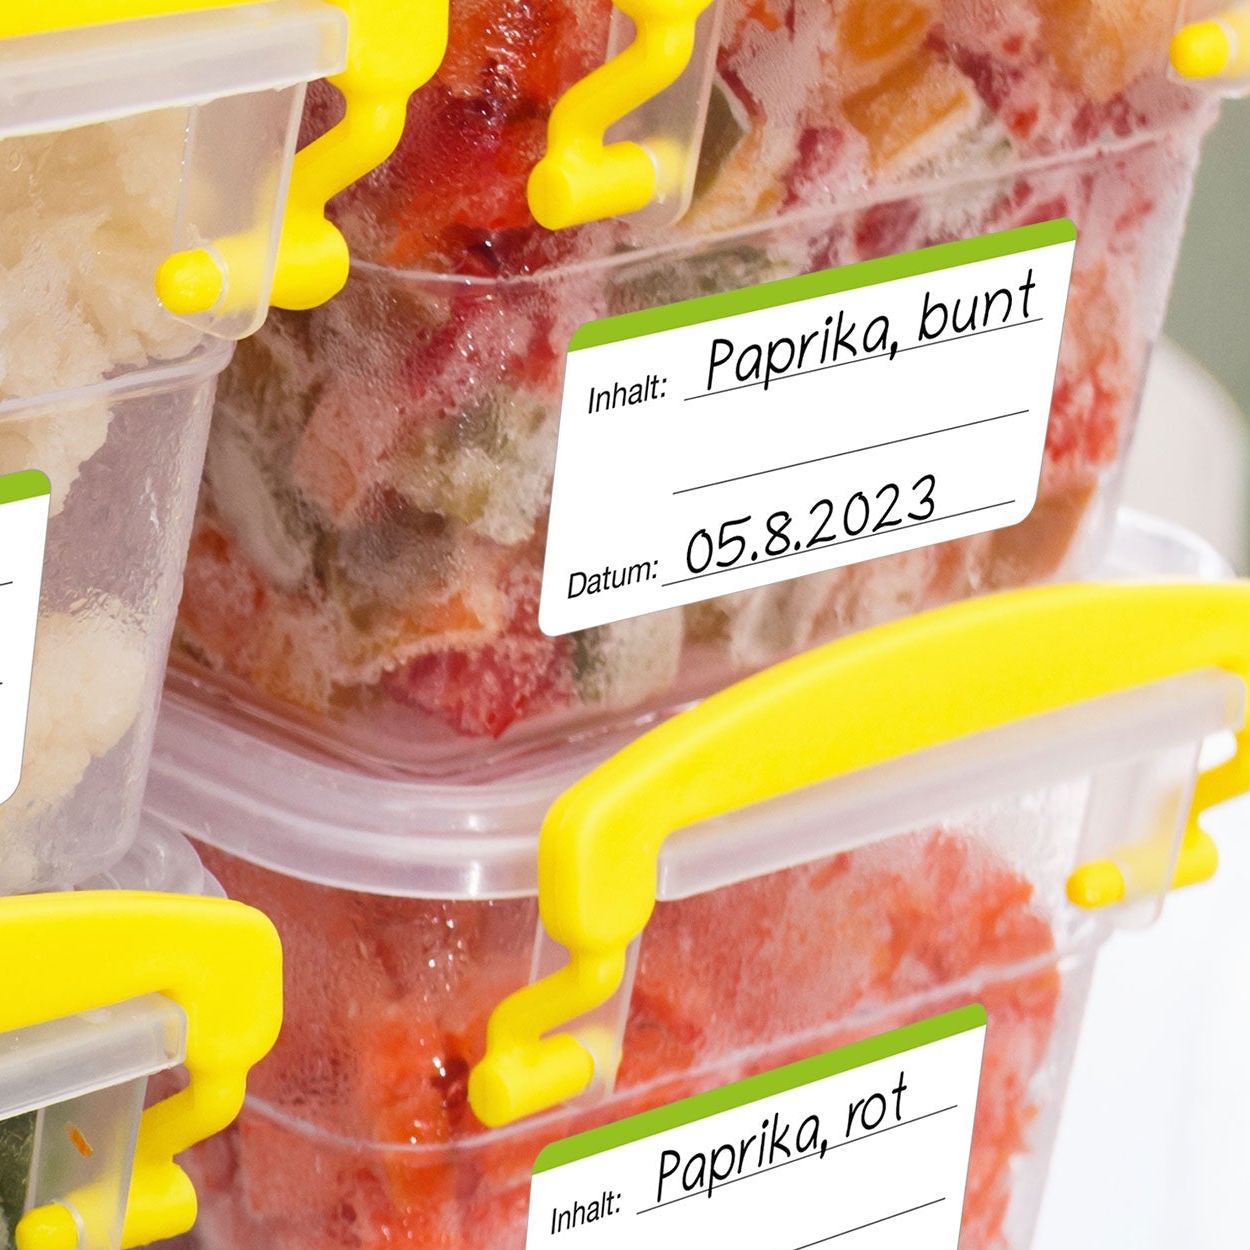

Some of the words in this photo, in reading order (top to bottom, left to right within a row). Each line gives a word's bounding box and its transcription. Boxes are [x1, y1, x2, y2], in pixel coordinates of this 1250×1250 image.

[587, 374, 667, 414] Inhalt:
[707, 310, 899, 391] Paprika,
[917, 268, 1036, 341] bunt
[566, 558, 659, 599] Datum:
[685, 474, 937, 575] 05.8.2023
[551, 1190, 622, 1235] Inhalt:
[656, 1112, 828, 1203] Paprika,
[845, 1071, 908, 1137] rot
